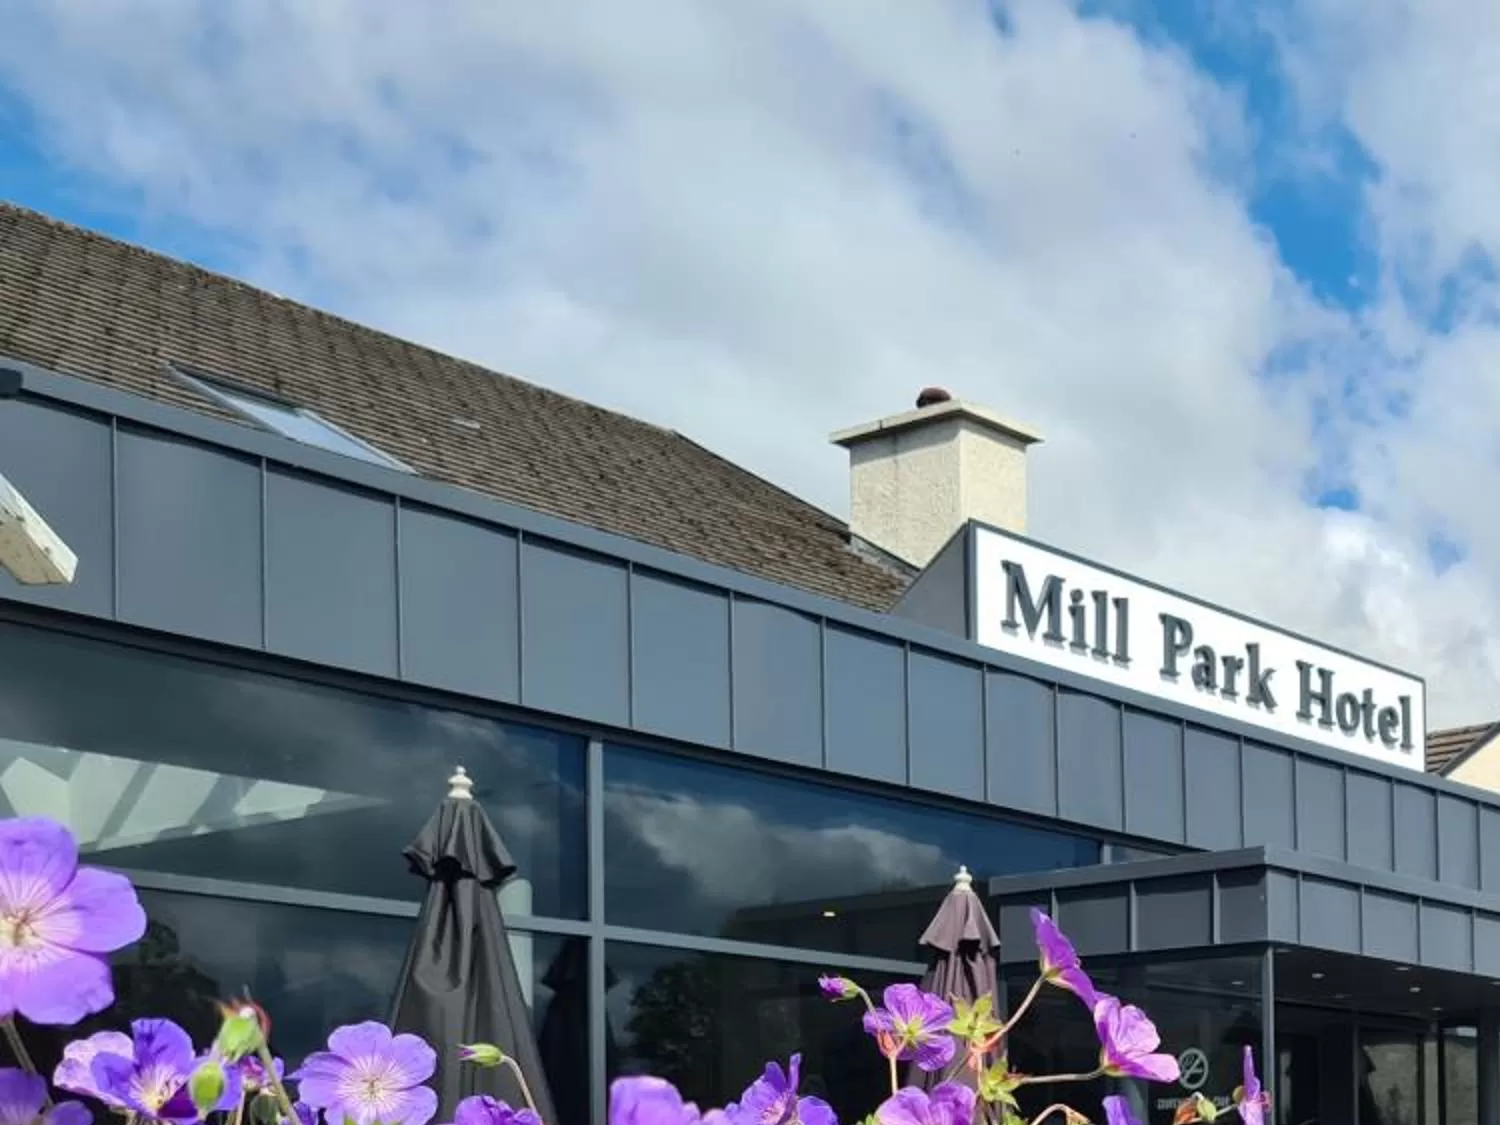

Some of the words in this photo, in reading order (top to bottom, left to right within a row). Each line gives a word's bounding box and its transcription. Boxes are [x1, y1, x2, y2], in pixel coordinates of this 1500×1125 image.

[1000, 559, 1132, 663] Mill
[1158, 612, 1278, 711] Park
[1296, 660, 1415, 750] Hotel
